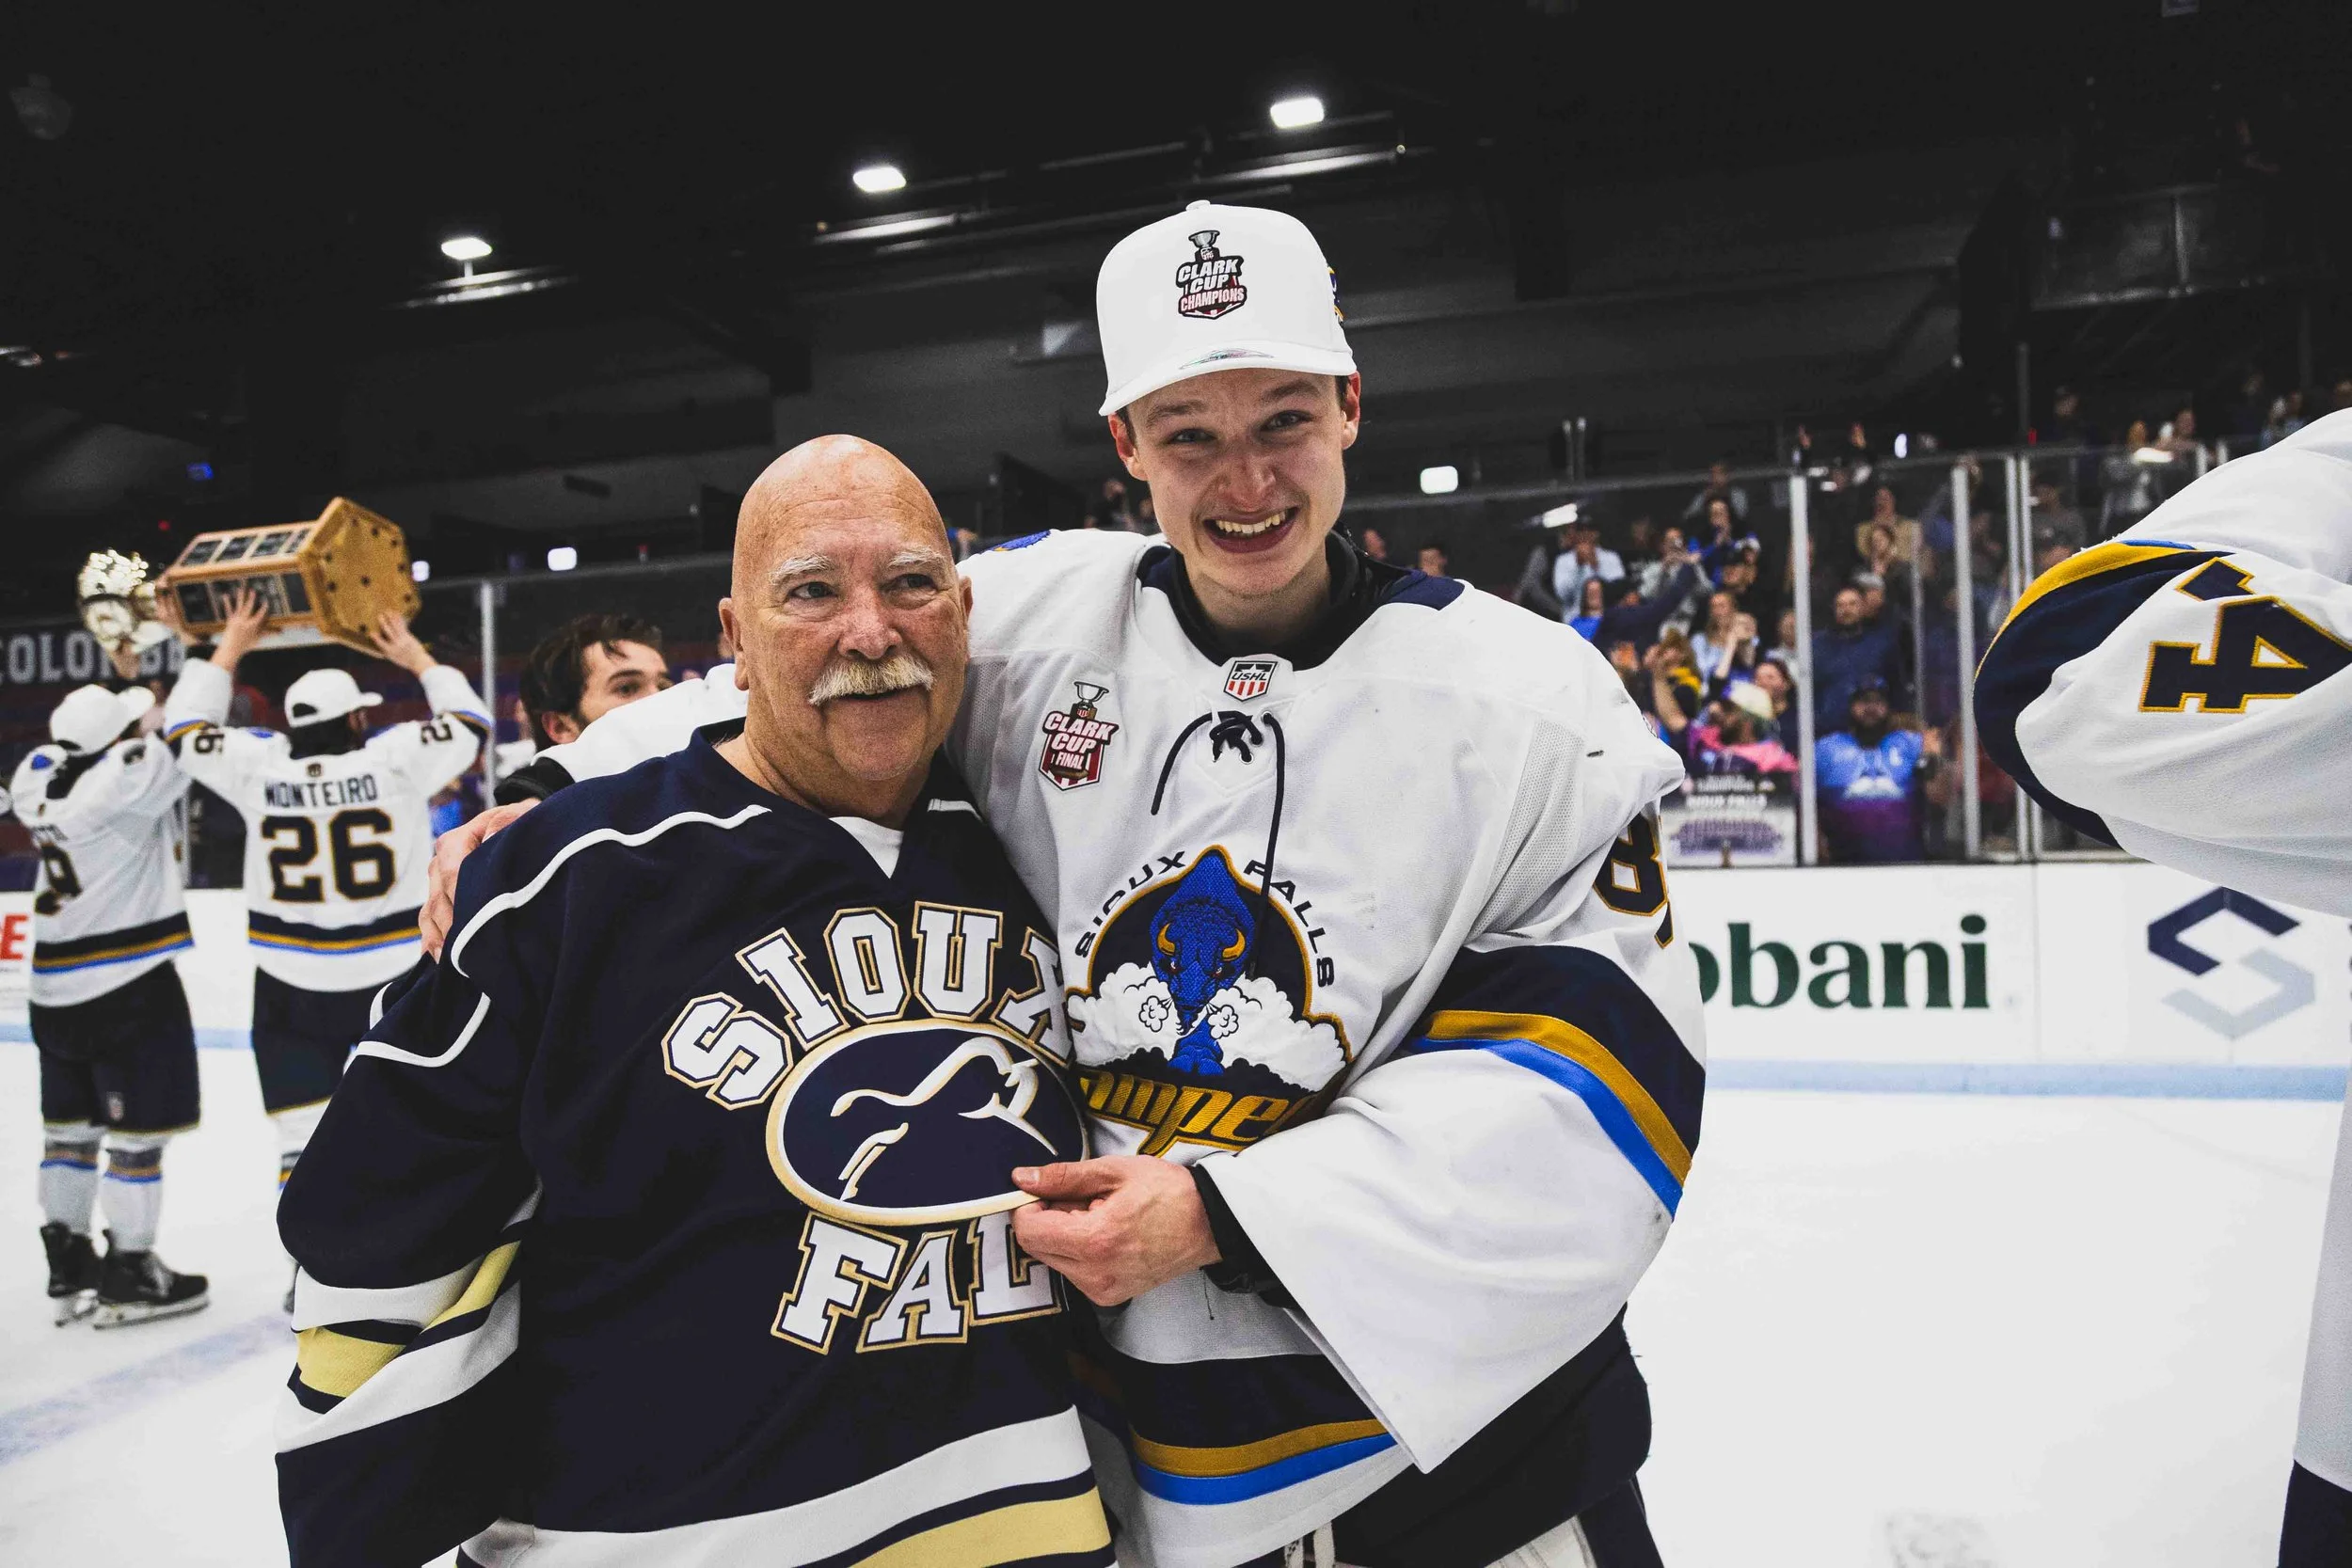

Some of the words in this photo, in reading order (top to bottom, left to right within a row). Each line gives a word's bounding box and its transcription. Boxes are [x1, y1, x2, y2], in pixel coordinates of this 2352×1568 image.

[1177, 258, 1239, 283] CLARK
[1189, 274, 1230, 293] CUP
[1181, 287, 1245, 311] CHAMPIONS
[1232, 672, 1268, 682] USHL
[1044, 713, 1117, 740] CLARK
[1051, 732, 1098, 752] CUP
[1056, 752, 1084, 769] FINAL
[264, 774, 378, 807] MONTEIRO
[261, 807, 395, 904] 26
[1075, 850, 1186, 958] SIOUX
[1244, 860, 1334, 988] FALLS
[661, 900, 1075, 1111] SIOUX
